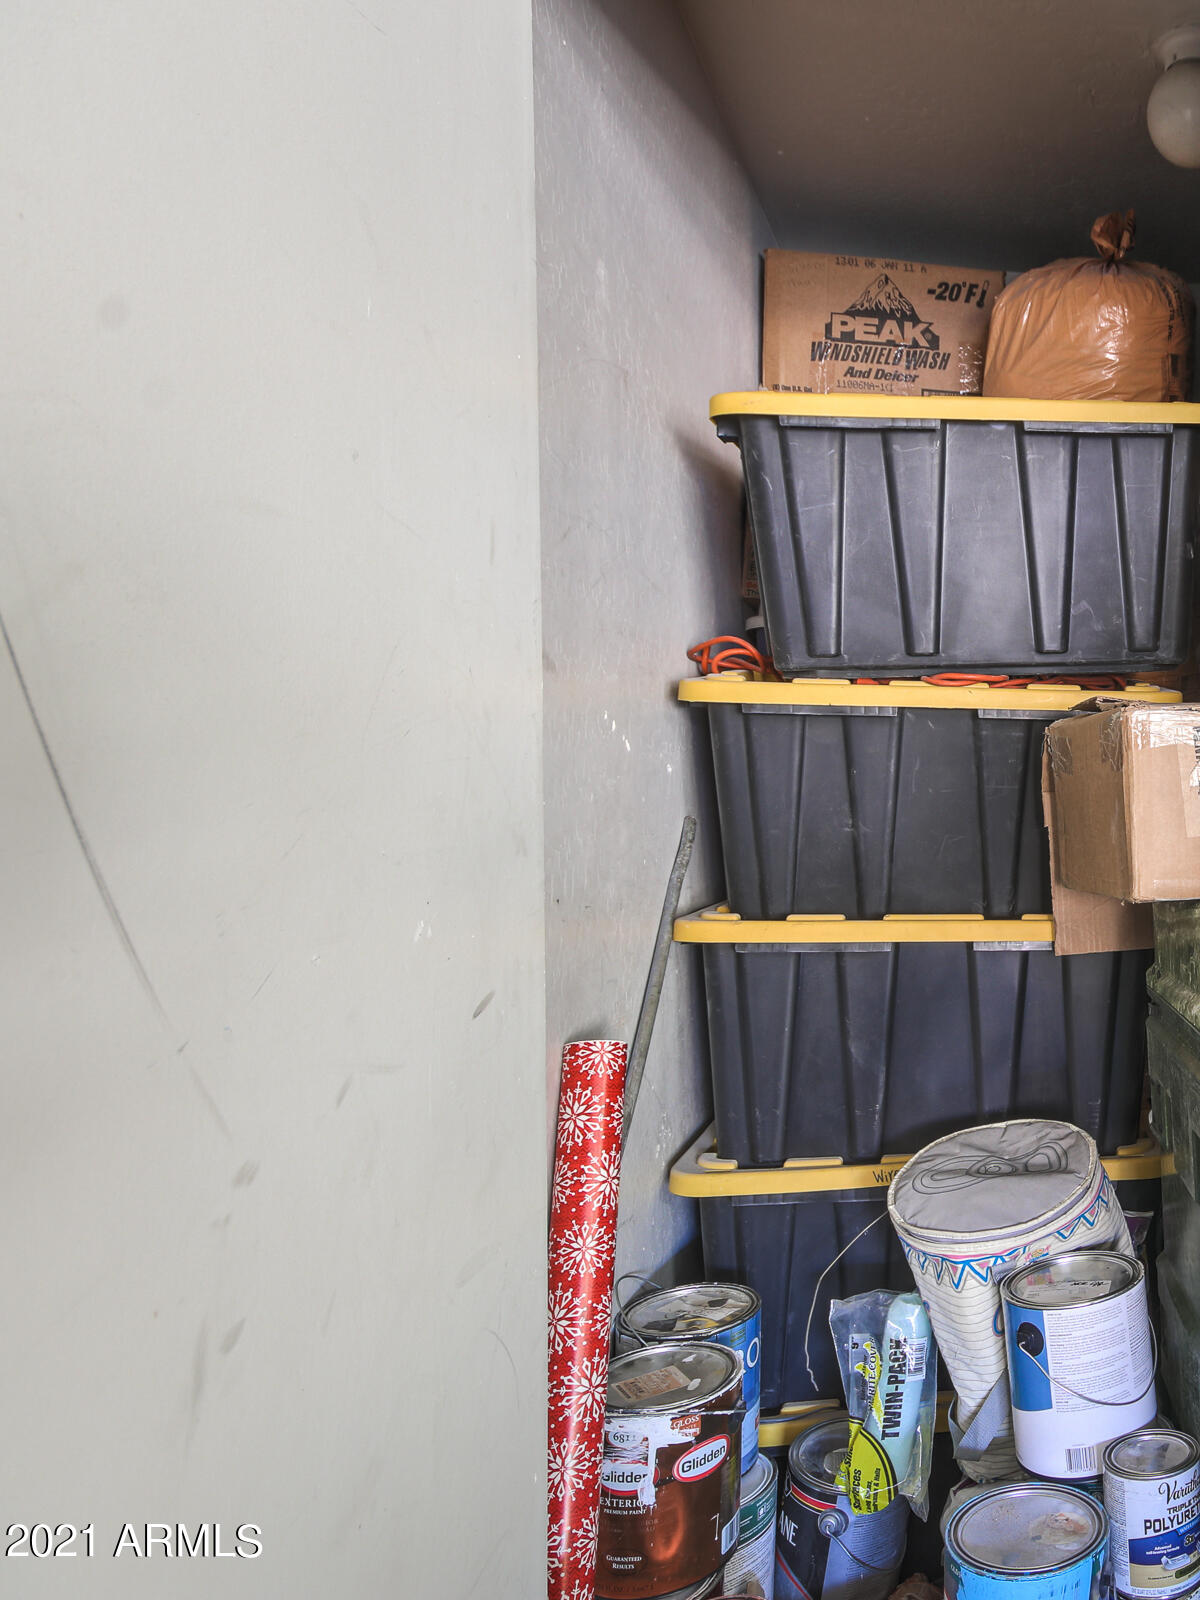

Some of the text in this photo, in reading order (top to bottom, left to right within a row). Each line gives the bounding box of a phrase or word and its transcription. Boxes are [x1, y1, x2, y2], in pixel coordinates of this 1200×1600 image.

[833, 314, 932, 347] PEAK
[811, 340, 952, 371] WINDSHIELD WASH
[844, 366, 920, 383] And Deicer
[881, 1338, 907, 1440] TWIN-PACK
[681, 1444, 726, 1474] Glidden
[600, 1496, 644, 1508] EXTERIO
[603, 1508, 628, 1516] PREMIUM
